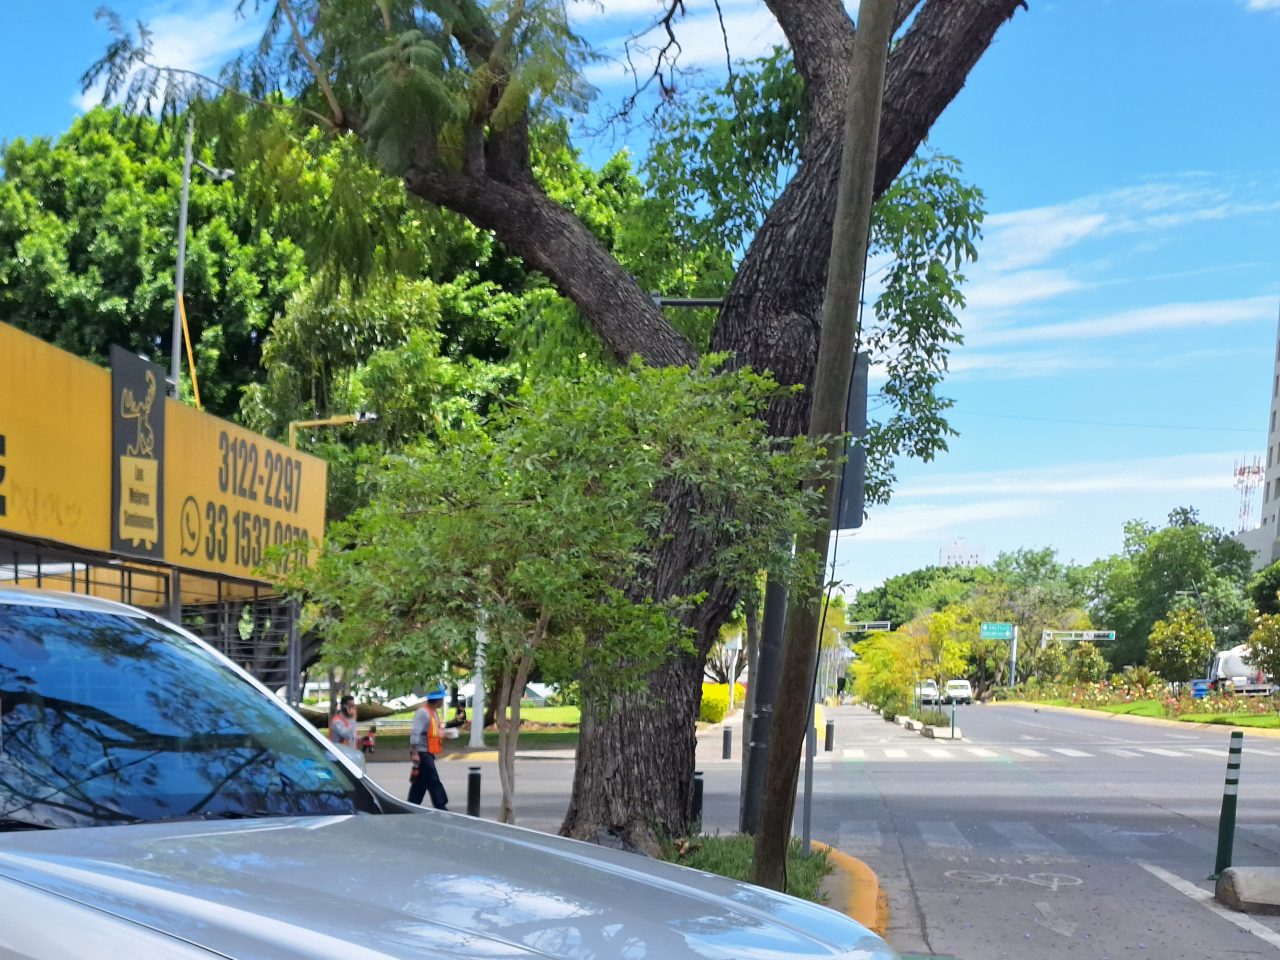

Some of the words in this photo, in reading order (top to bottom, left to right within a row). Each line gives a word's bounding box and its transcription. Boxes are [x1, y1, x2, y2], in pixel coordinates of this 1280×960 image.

[218, 430, 302, 514] 3122-2297
[204, 501, 228, 563] 33
[233, 510, 270, 568] 1537
